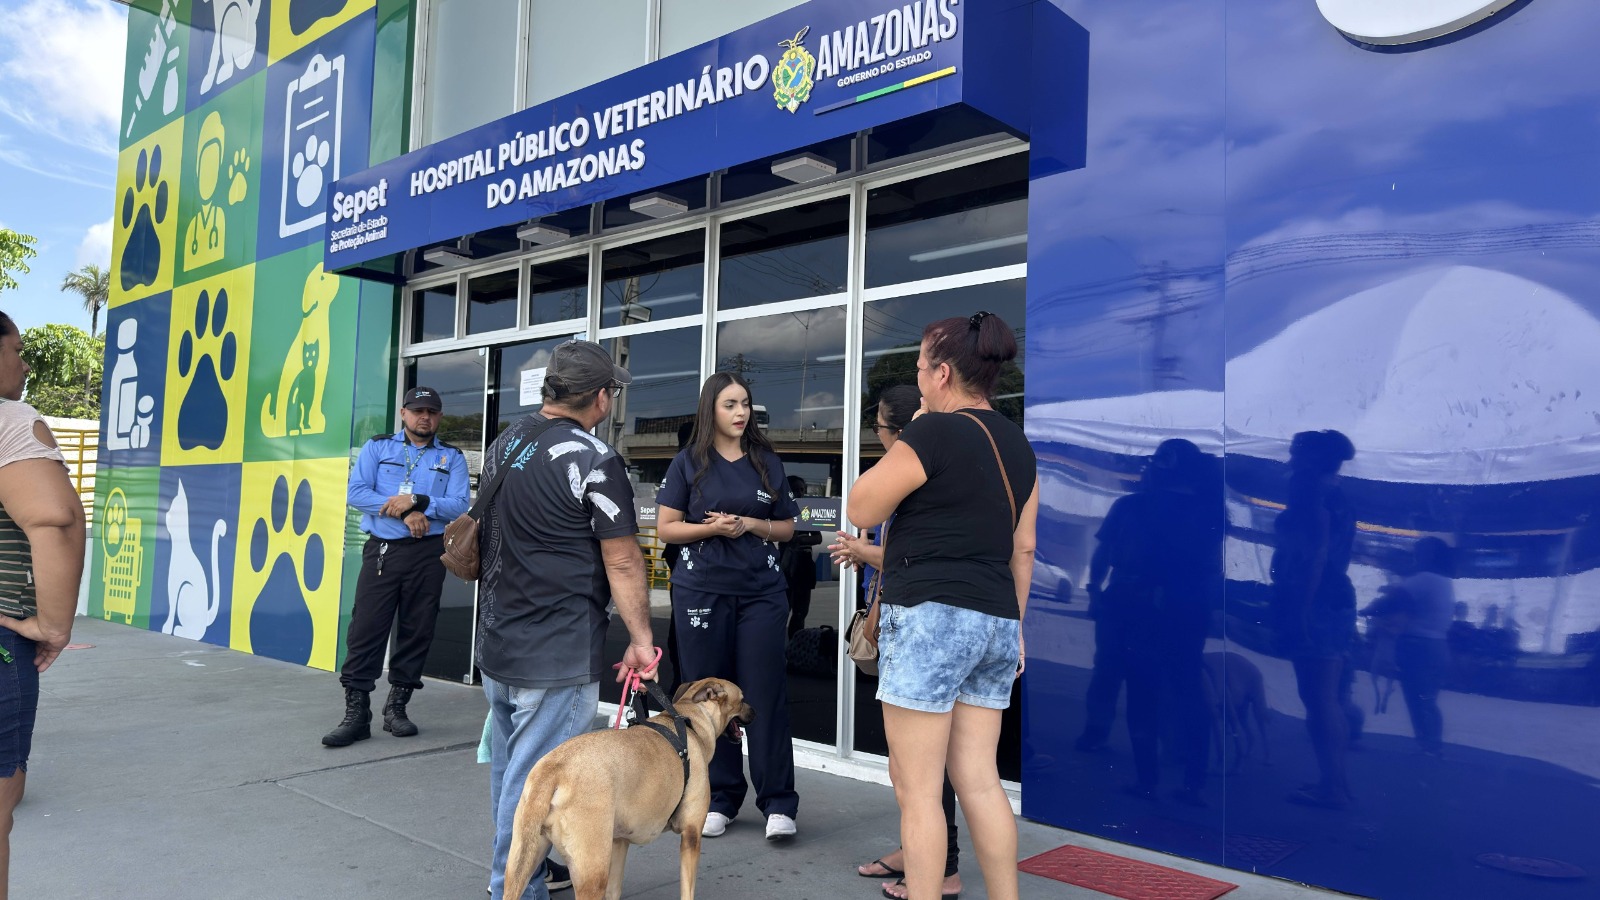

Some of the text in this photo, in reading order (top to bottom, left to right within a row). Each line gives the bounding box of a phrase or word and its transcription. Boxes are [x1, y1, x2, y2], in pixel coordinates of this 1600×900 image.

[816, 0, 958, 81] AMAZONAS
[837, 50, 932, 88] GOVERNO DO ESTADO
[410, 54, 770, 197] HOSPITAL PÚBLICO VETERINÁRIO
[487, 138, 646, 209] DO AMAZONAS
[332, 178, 388, 223] Sepet
[329, 226, 388, 253] de Proteção Animal
[330, 215, 388, 241] Secretaria de Estado
[640, 506, 656, 515] Sepet
[811, 508, 837, 519] AMAZONAS
